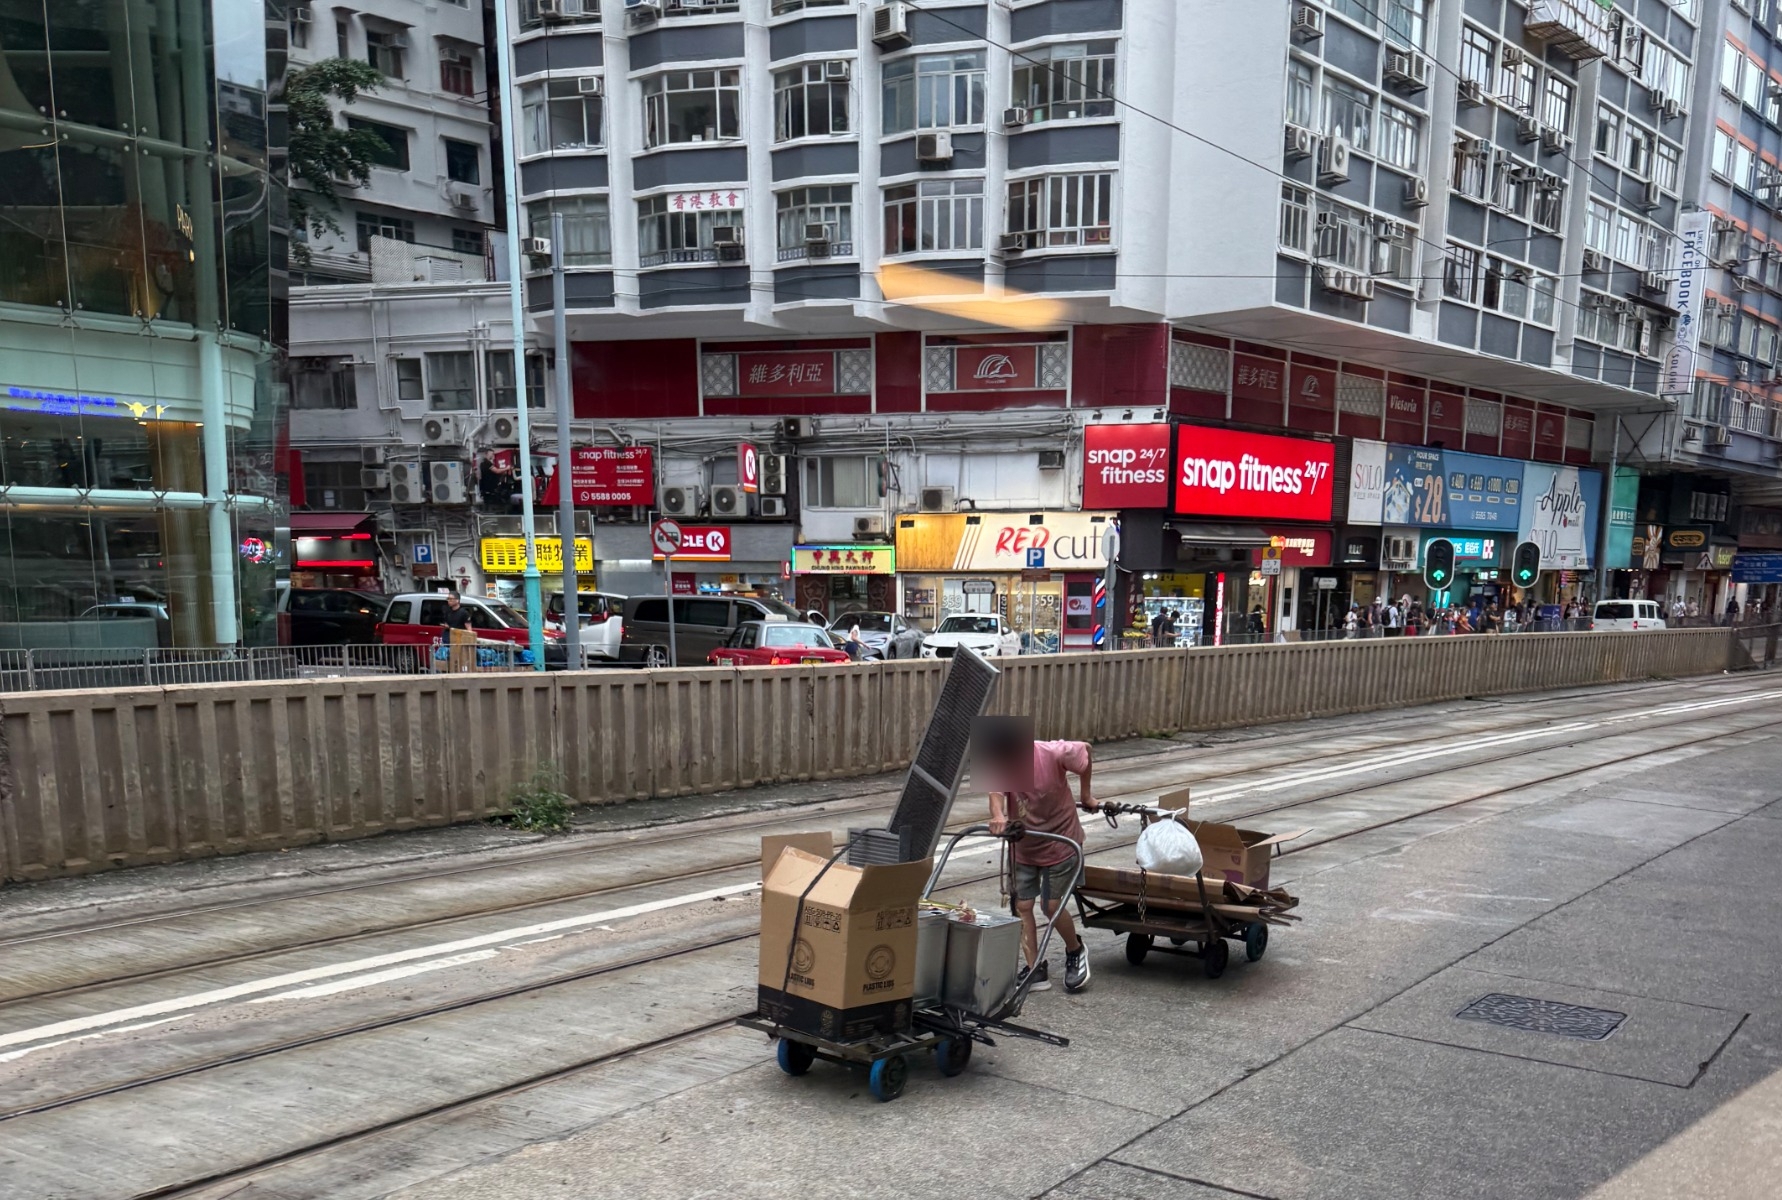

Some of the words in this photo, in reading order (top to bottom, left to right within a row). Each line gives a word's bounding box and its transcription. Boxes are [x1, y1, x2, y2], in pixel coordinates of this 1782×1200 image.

[1677, 231, 1696, 309] FACEBOOK
[748, 363, 824, 386] 維多利亞
[1390, 394, 1417, 413] Victoria
[579, 450, 602, 461] snap
[604, 449, 635, 459] fitness
[1088, 448, 1136, 468] snap
[1140, 448, 1166, 468] 24/7
[1101, 466, 1165, 485] fitness
[1182, 457, 1236, 494] snap
[1239, 453, 1303, 495] fitness
[1304, 460, 1330, 496] 24/7
[1355, 463, 1382, 490] SOLO
[1540, 474, 1581, 526] Apple
[996, 526, 1049, 557] RED
[1053, 525, 1102, 560] cut
[417, 546, 428, 561] P
[1029, 549, 1043, 566] P
[862, 980, 883, 992] PLASTIC
